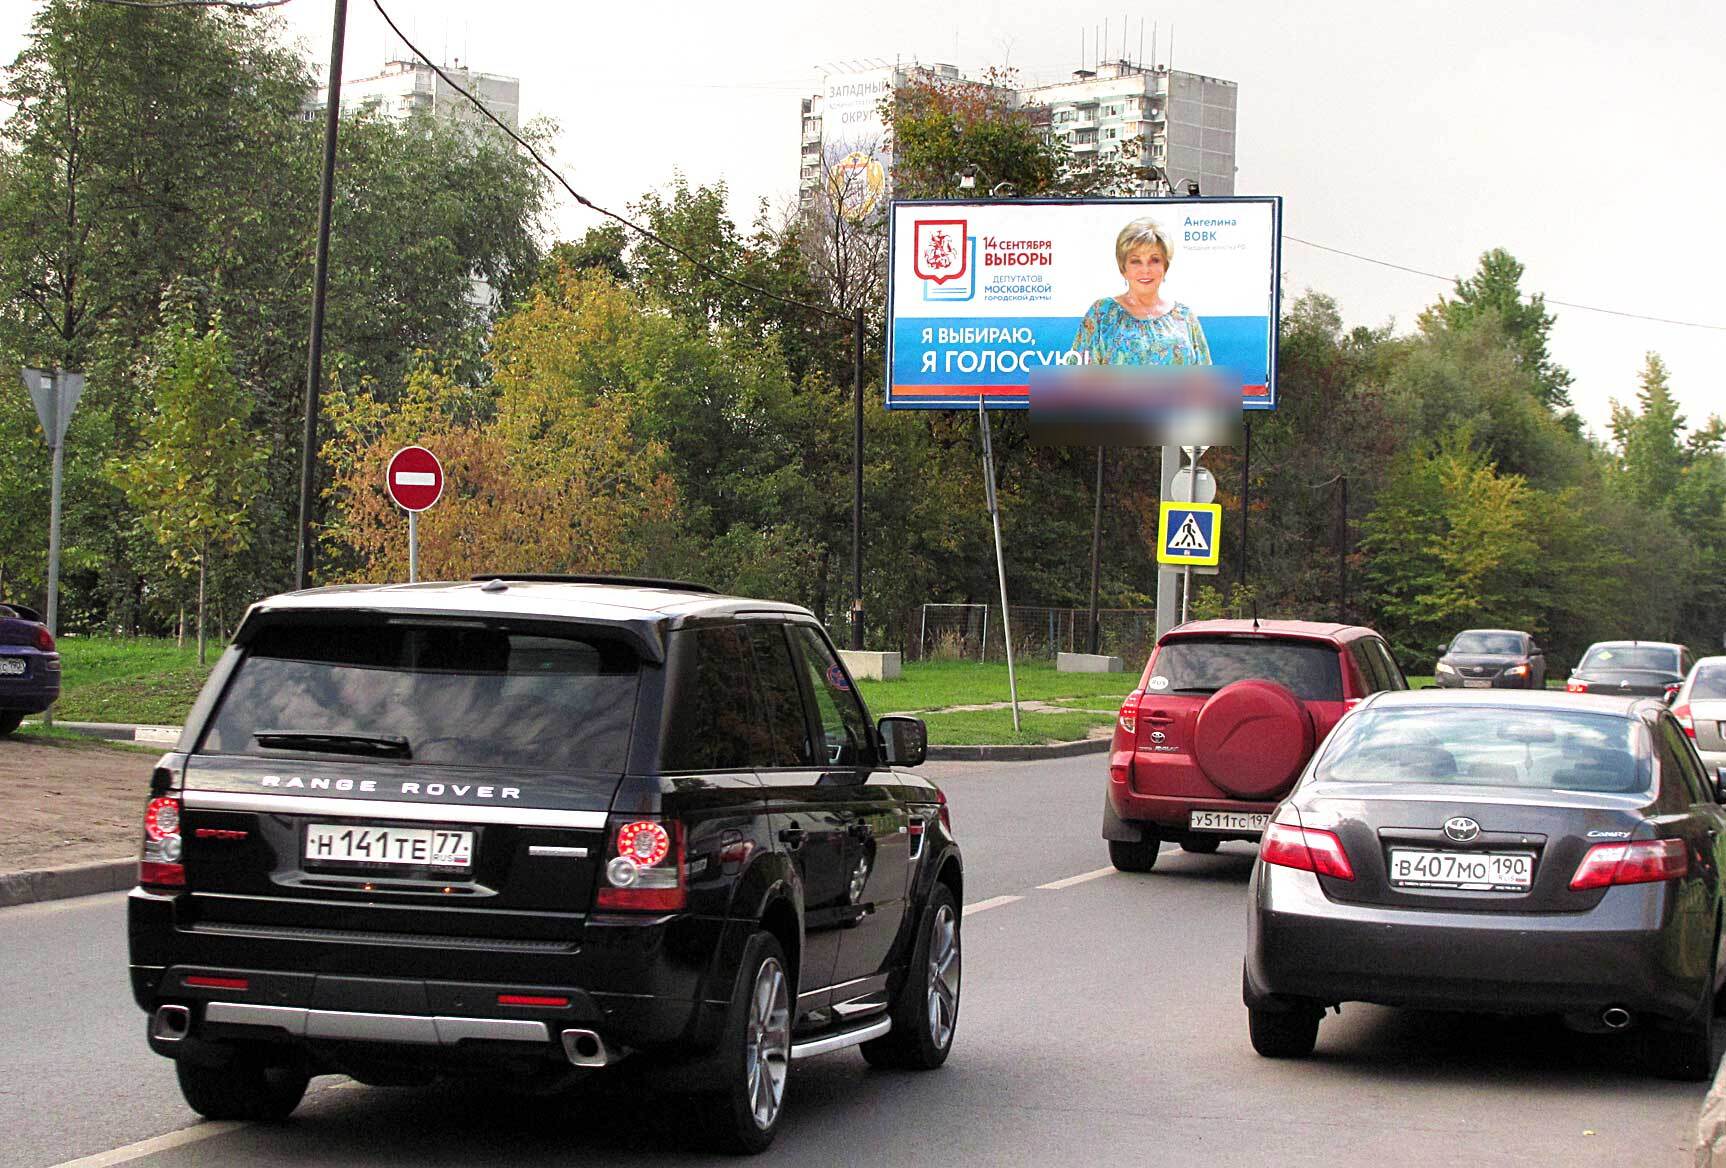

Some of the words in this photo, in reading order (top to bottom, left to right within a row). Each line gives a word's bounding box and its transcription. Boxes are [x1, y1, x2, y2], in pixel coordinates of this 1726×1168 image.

[841, 110, 876, 124] ОКРУГ
[1184, 216, 1237, 227] Ангелина
[983, 236, 997, 250] 14
[999, 240, 1052, 250] СЕНТЯБРЯ
[1184, 231, 1217, 241] ВОВК
[985, 253, 1052, 266] ВЫБОРЫ
[992, 275, 1043, 284] ДЕПУТАТОВ
[985, 283, 1052, 293] МОСКОВСКОЙ
[921, 327, 933, 344] Я
[938, 327, 1036, 346] ВЫБИРАЮ,
[920, 350, 937, 373] Я
[262, 775, 377, 792] RANGE
[401, 782, 520, 799] ROVER
[435, 832, 463, 854] 77
[432, 853, 455, 862] RUS
[1492, 858, 1524, 875] 190
